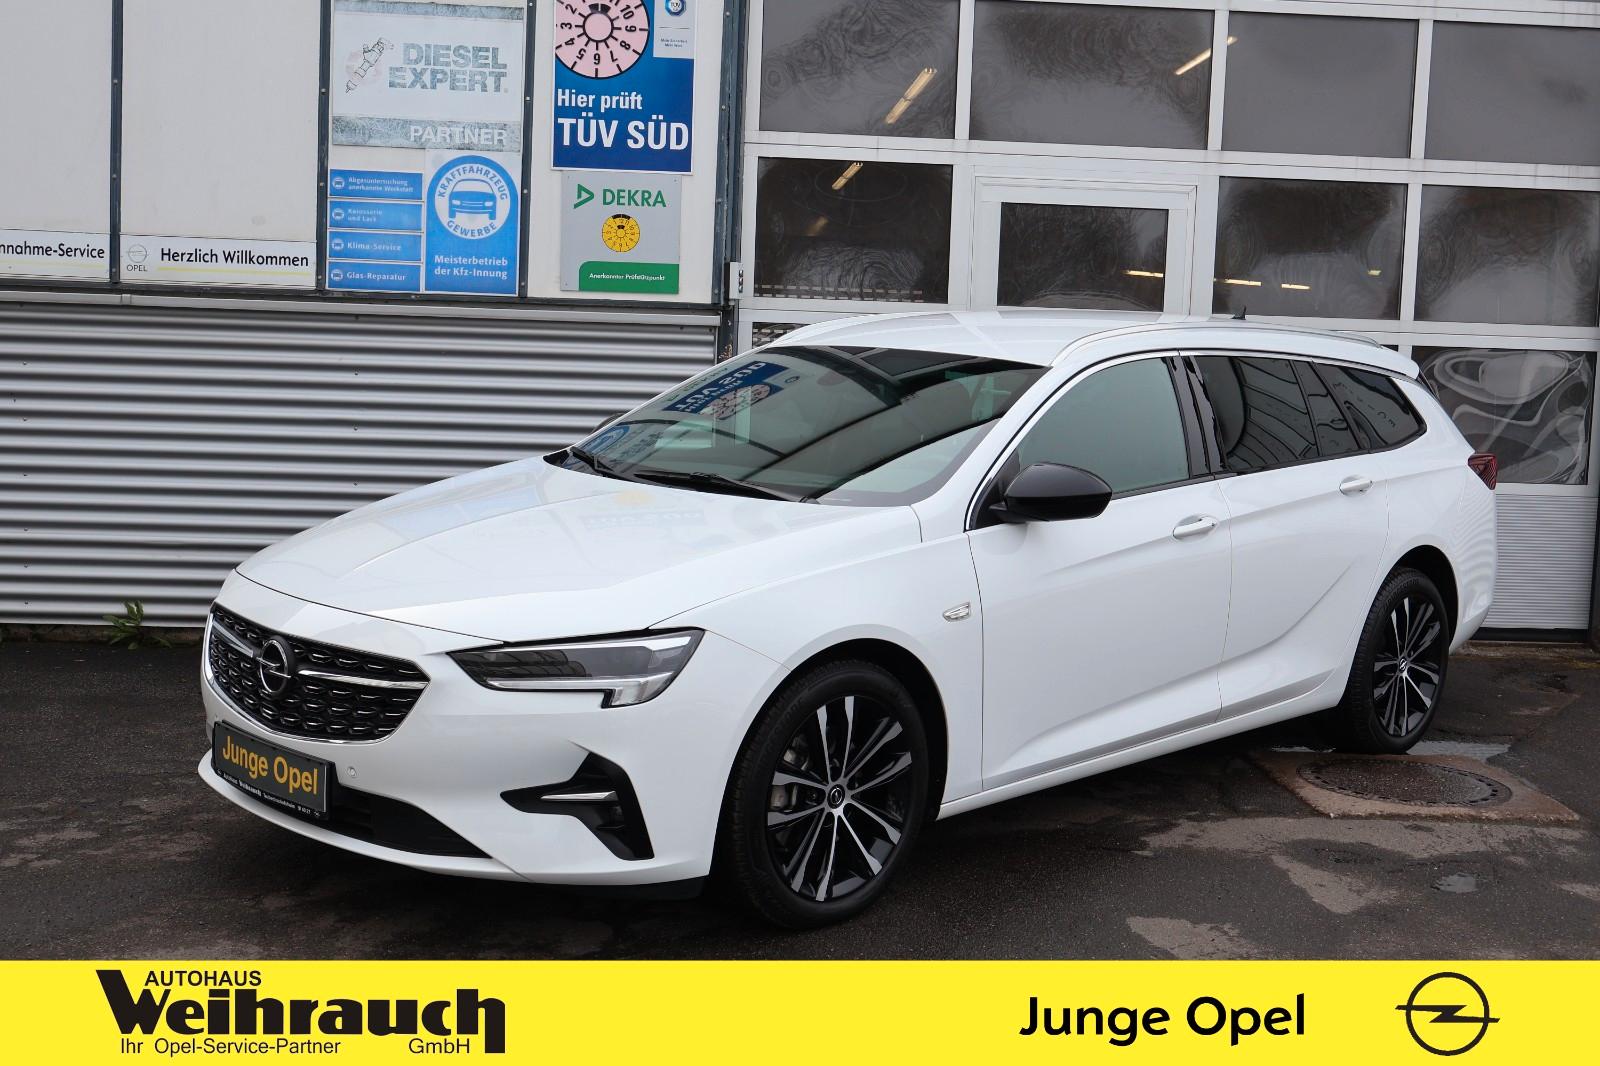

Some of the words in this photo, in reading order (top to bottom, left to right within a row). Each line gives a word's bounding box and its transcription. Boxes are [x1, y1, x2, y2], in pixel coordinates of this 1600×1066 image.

[402, 42, 508, 70] DIESEL
[557, 88, 596, 107] Hier
[600, 91, 643, 113] prüft
[410, 125, 507, 145] PARTNER
[557, 111, 619, 148] TÜV
[626, 114, 689, 150] SÜD
[437, 165, 508, 201] KRAFTFAHRZEUG
[602, 188, 667, 208] DEKRA
[446, 220, 498, 238] GEWERBE
[347, 242, 402, 251] Klima-Service
[160, 247, 219, 264] Herzlich
[222, 249, 309, 267] Willkommen
[434, 255, 508, 266] Meisterbetrieb
[126, 264, 148, 272] OPEL
[346, 271, 408, 281] Glas-Reparatur
[434, 266, 451, 275] der
[453, 267, 508, 280] Kfz-Innung
[222, 735, 269, 780] Junge
[273, 756, 318, 795] Opel
